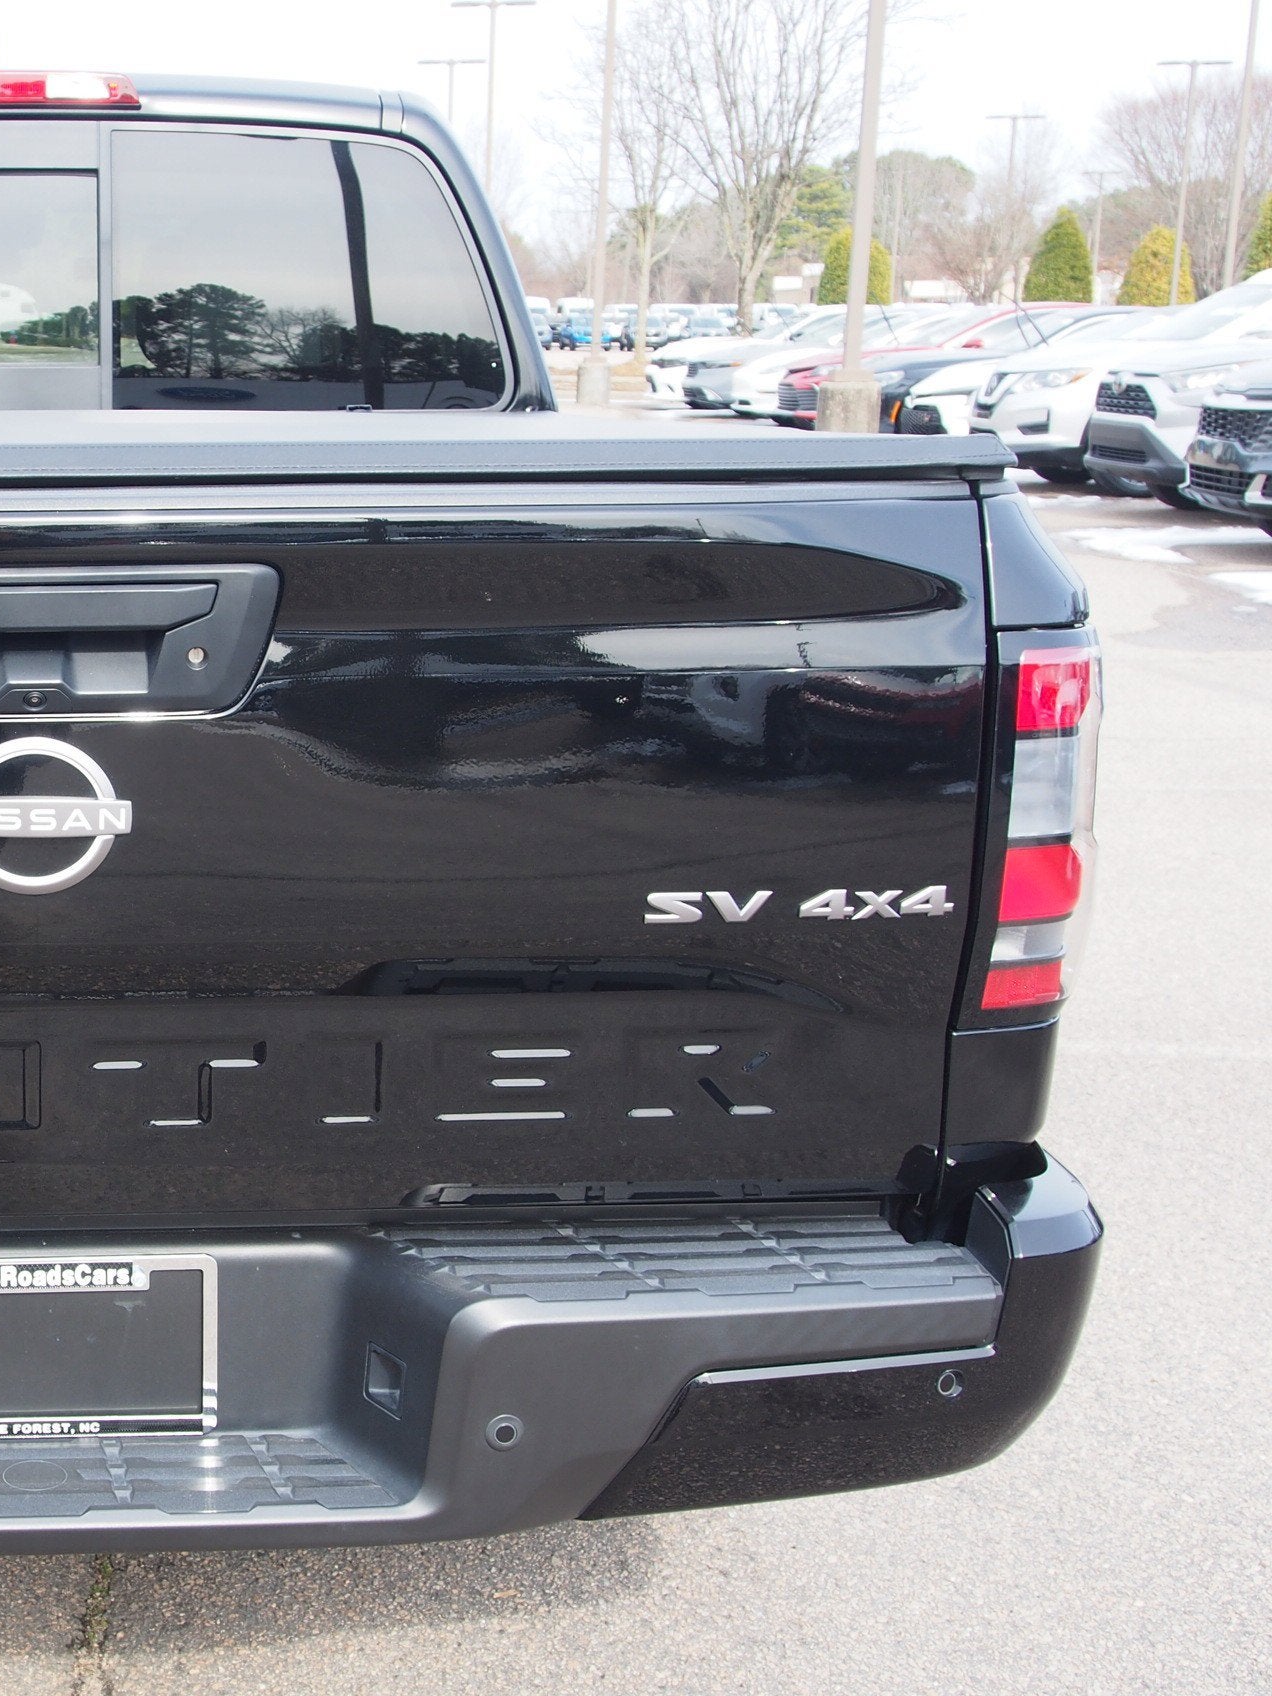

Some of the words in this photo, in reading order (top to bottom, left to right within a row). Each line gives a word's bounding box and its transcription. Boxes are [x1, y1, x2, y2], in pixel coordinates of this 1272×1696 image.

[643, 890, 774, 924] SV
[799, 885, 955, 920] 4x4
[12, 1422, 76, 1435] FOREST,
[79, 1422, 100, 1433] NC
